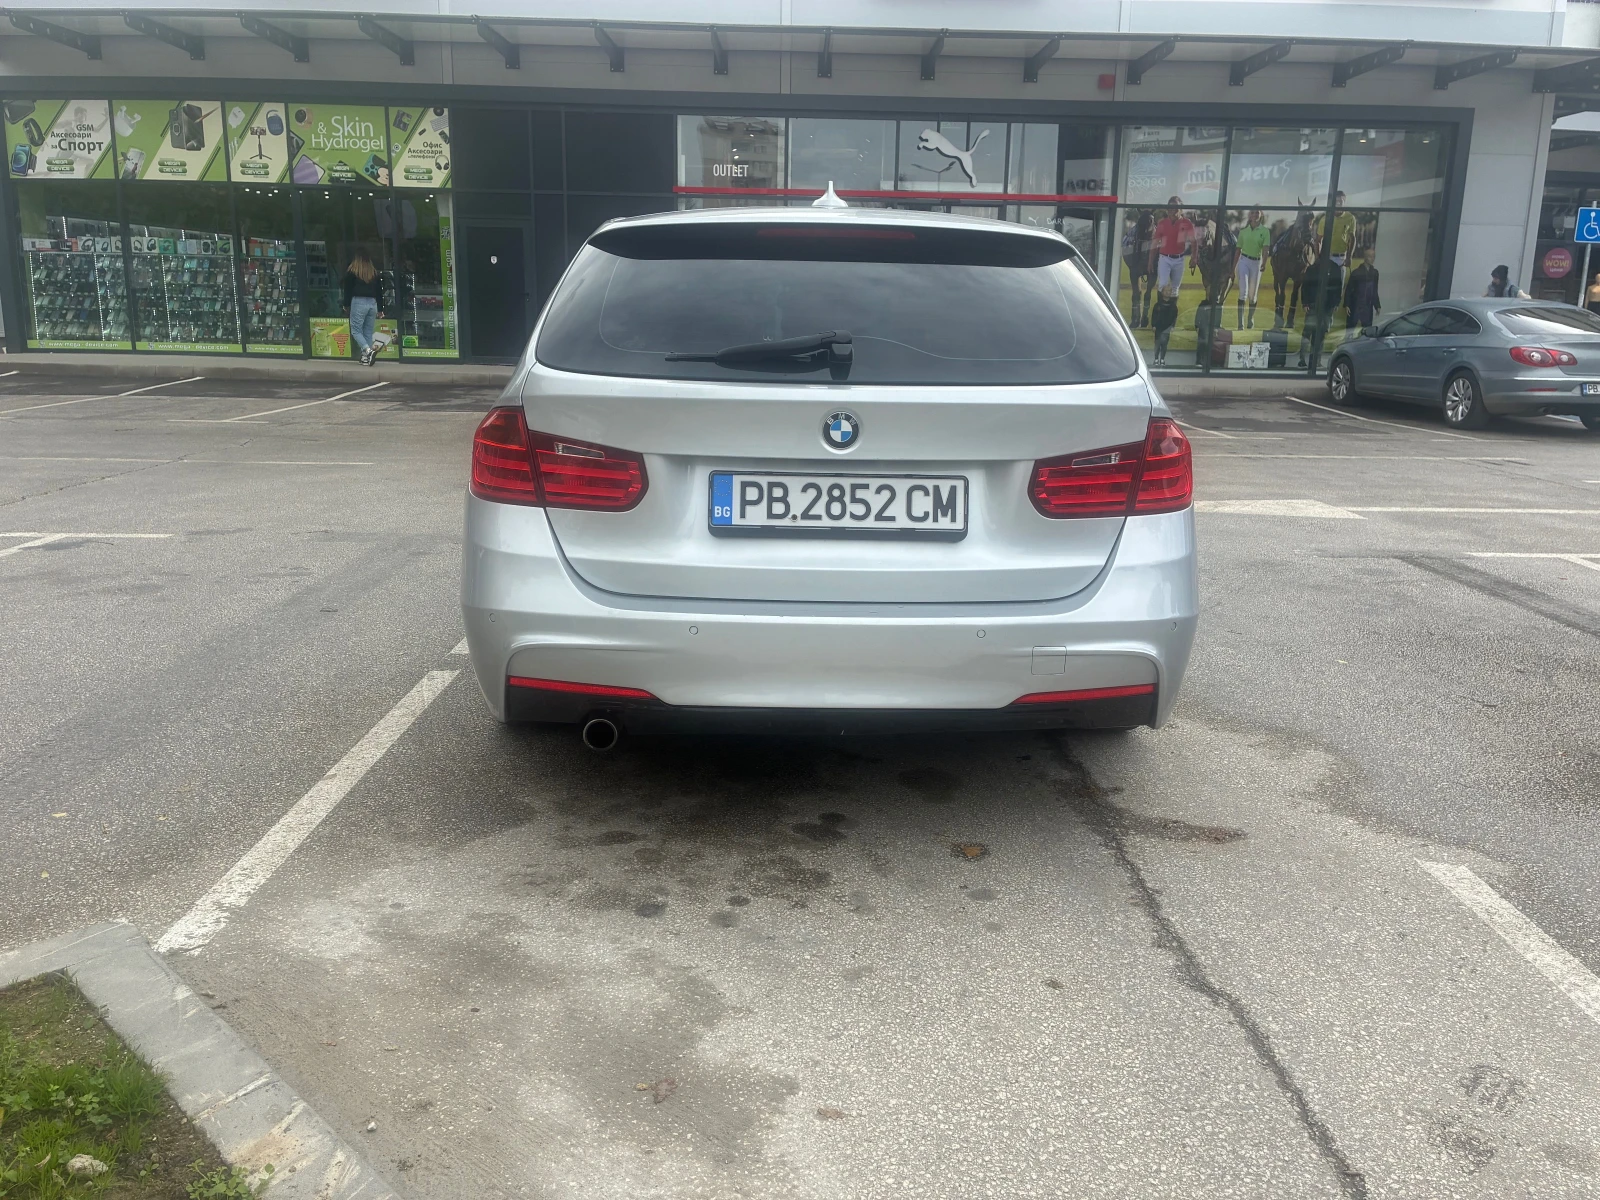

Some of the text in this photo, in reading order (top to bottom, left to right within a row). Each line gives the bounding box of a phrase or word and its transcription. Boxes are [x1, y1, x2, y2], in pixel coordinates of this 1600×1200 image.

[76, 123, 95, 132] GSM
[317, 115, 374, 137] & Skin
[50, 131, 92, 139] Аксесоари
[58, 138, 104, 154] Спорт
[311, 134, 384, 153] Hydrogel
[422, 141, 443, 150] Офис
[407, 147, 443, 156] Аксесоари
[712, 163, 749, 177] OUTLET
[1545, 259, 1570, 268] WOW!
[1588, 384, 1598, 392] PB
[826, 413, 857, 426] BMW
[905, 484, 957, 523] CM
[714, 506, 731, 517] BG
